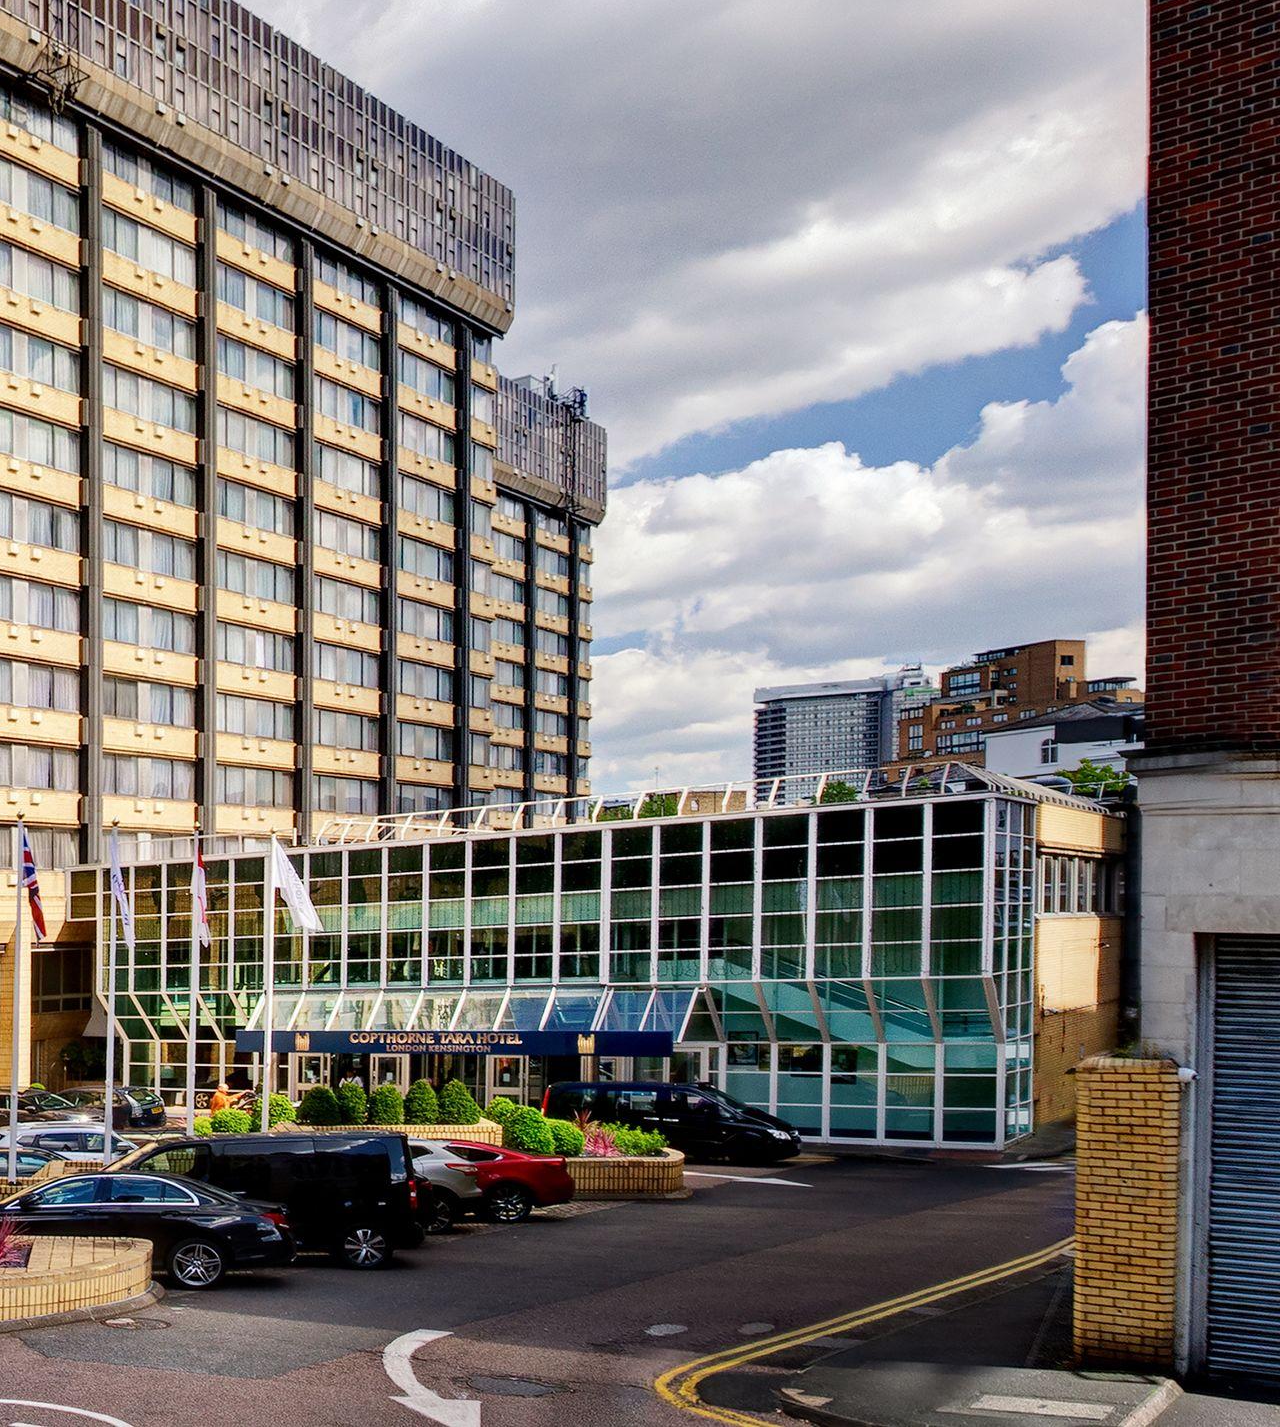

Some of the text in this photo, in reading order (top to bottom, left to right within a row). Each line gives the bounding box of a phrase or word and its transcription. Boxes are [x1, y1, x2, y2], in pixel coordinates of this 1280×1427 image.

[349, 1032, 523, 1046] COPTHORNE TARA HOTEL
[386, 1044, 491, 1053] LONDON KENSINGTON
